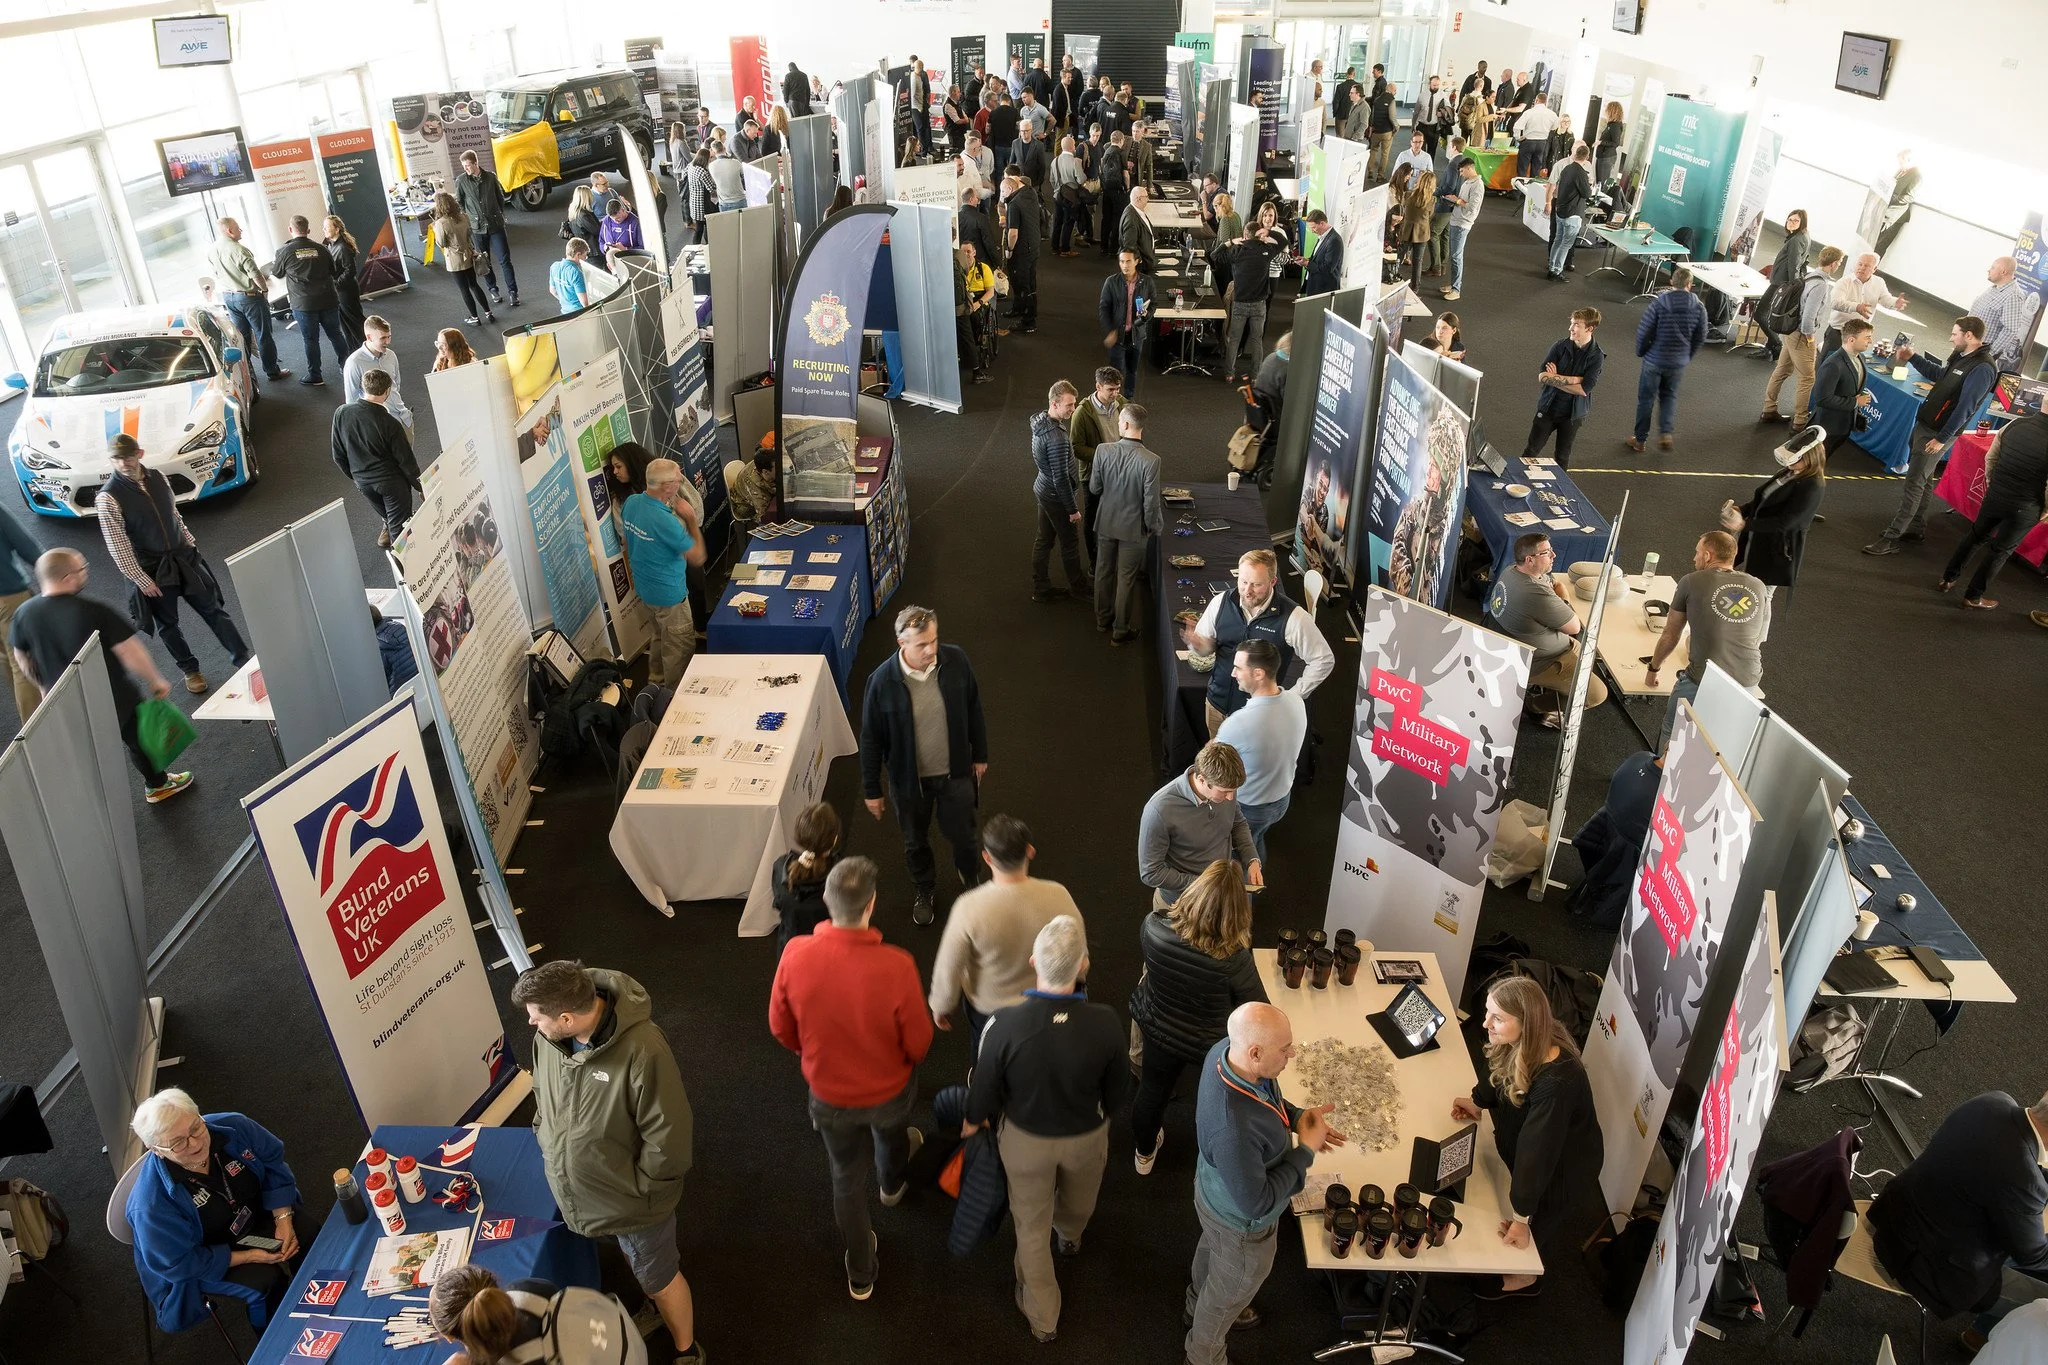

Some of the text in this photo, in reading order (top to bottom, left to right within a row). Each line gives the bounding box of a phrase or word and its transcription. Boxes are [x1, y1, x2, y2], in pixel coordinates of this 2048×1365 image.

[180, 41, 208, 52] AWE
[792, 359, 850, 375] RECRUITING
[807, 372, 834, 382] NOW
[602, 392, 624, 409] Benefits
[804, 387, 820, 395] Spare
[820, 388, 834, 396] Time
[835, 389, 850, 397] Roles
[466, 480, 485, 504] Network
[533, 483, 561, 519] EMPLOYER
[535, 487, 570, 532] RECOGNITION
[538, 514, 561, 545] SCHEME
[1377, 677, 1412, 703] PwC
[1400, 716, 1461, 757] Military
[1380, 735, 1443, 776] Network
[1657, 807, 1678, 846] PwC
[1343, 861, 1370, 880] pwc
[337, 866, 391, 924] Blind
[343, 866, 430, 942] Veterans
[1644, 875, 1678, 944] Network
[1661, 861, 1691, 925] Military
[352, 929, 383, 963] UK
[355, 914, 453, 1004] Life beyond sight loss
[359, 925, 456, 1015] St Dunstan's since 1915
[372, 958, 466, 1049] blindveterans.org.uk
[311, 1341, 323, 1355] Blind
[317, 1334, 334, 1355] Veterans
